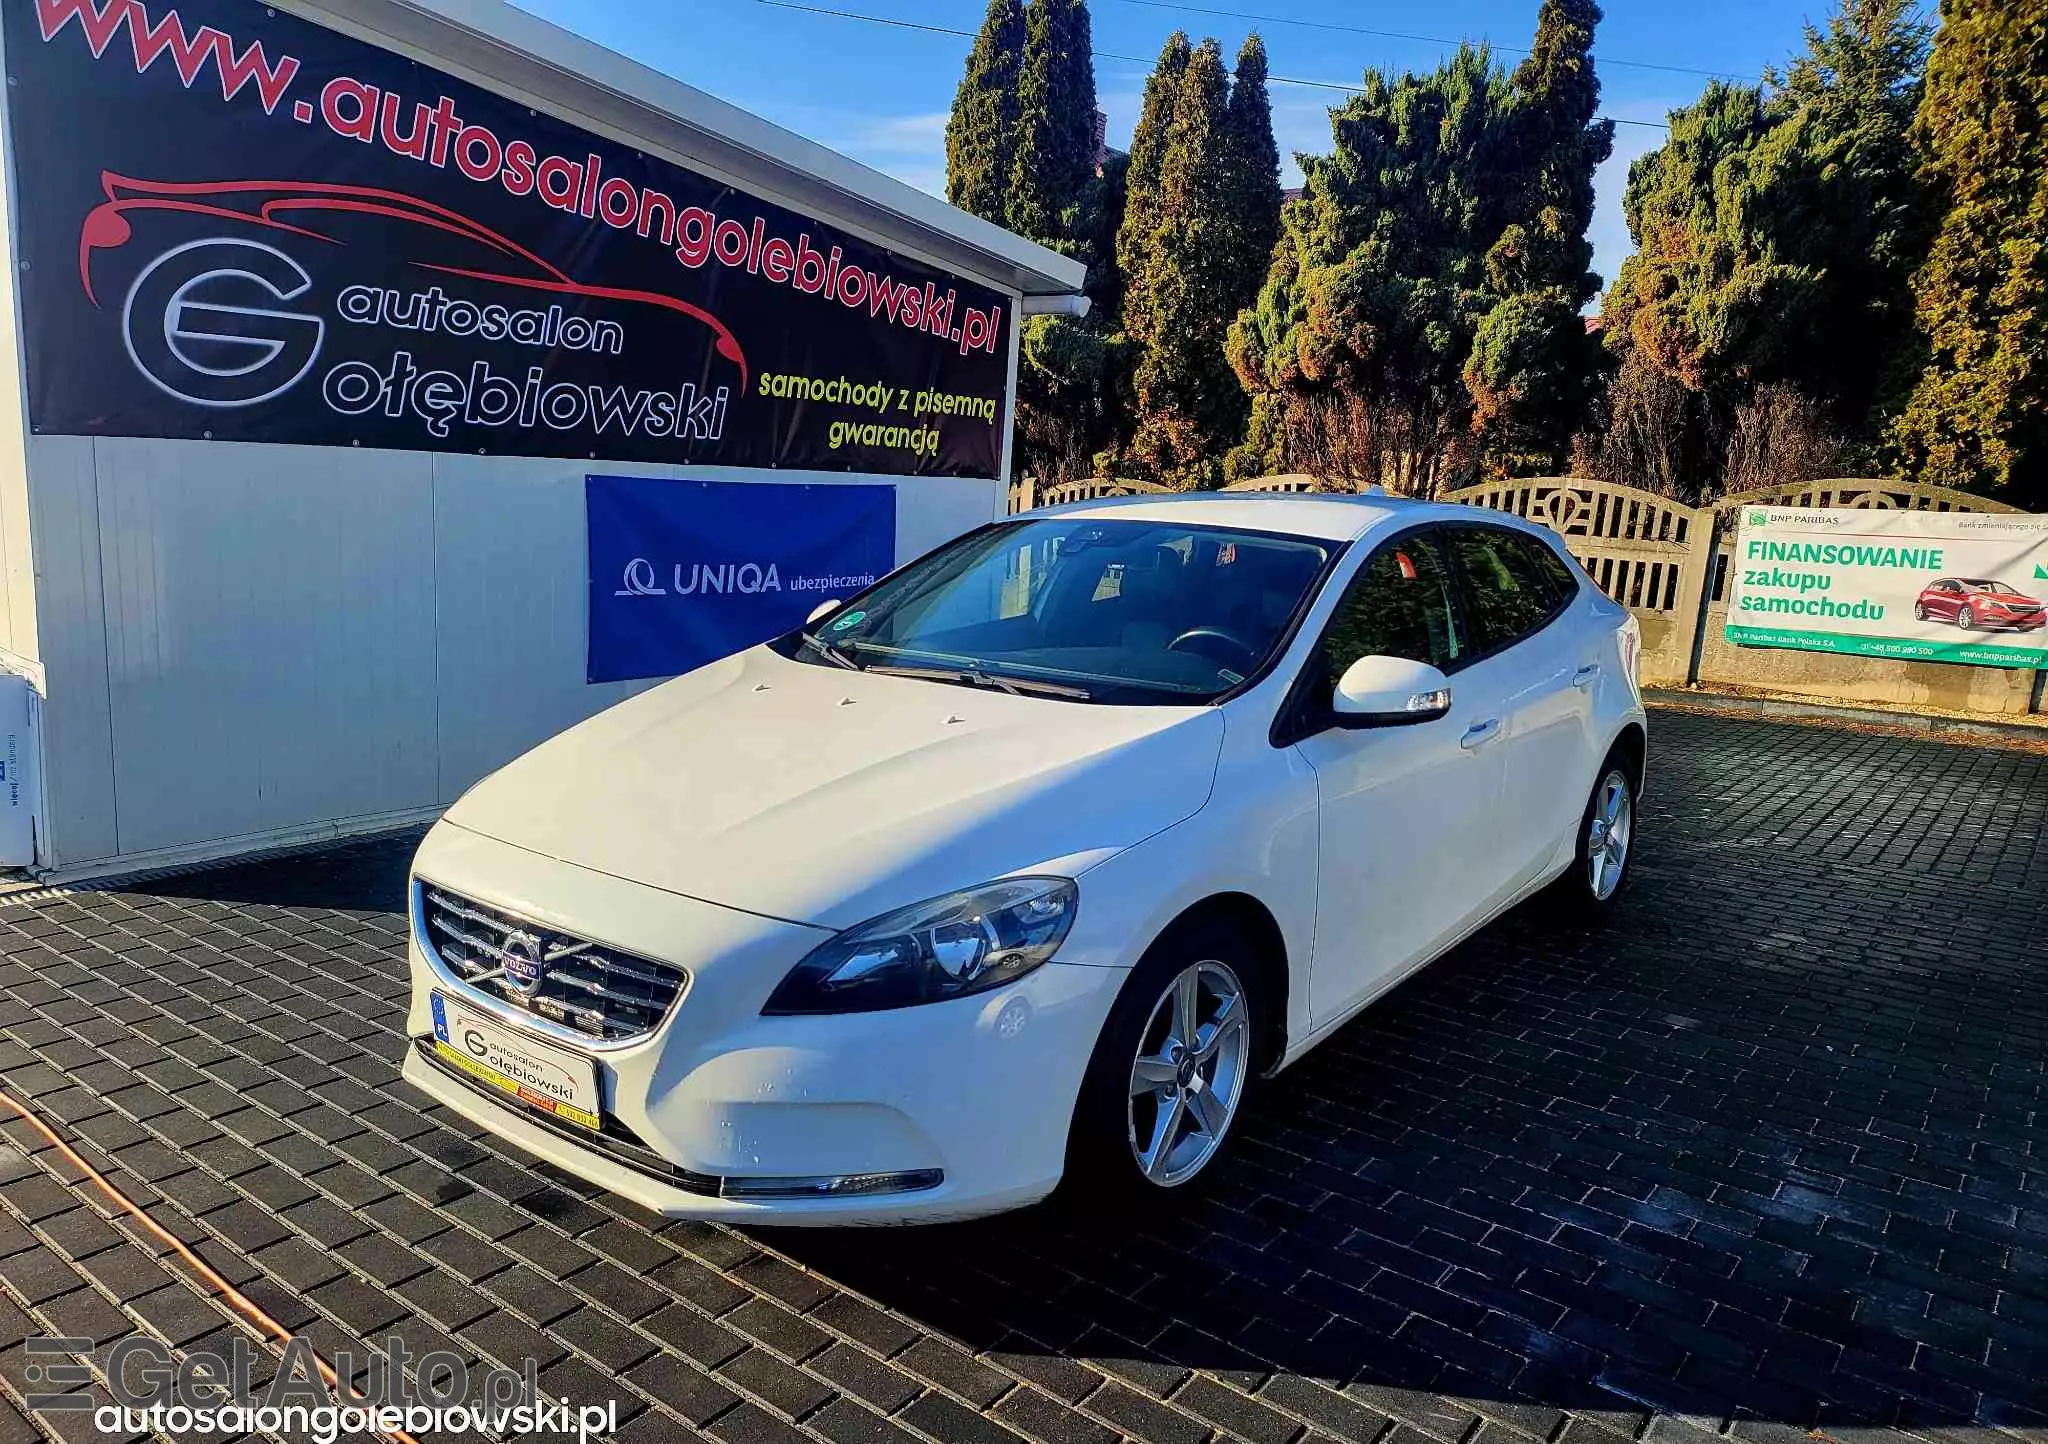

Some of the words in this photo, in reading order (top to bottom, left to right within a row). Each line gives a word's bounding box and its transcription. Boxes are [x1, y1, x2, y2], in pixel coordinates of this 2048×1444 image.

[34, 0, 1002, 356] www.autosalongolebiowski.pl
[336, 284, 624, 354] autosalon
[758, 372, 894, 413] samochody
[897, 388, 908, 411] z
[914, 386, 997, 424] pisemną
[828, 419, 941, 456] gwarancją
[1770, 513, 1793, 523] BNP
[1795, 514, 1840, 526] PARIBAS
[1747, 540, 1944, 570] FINANSOWANIE
[674, 562, 782, 595] UNIQA
[790, 571, 875, 593] ubezpieczenia
[1743, 568, 1832, 595] zakupu
[1740, 595, 1885, 622] samochodu
[504, 956, 537, 976] VOLVO
[437, 1023, 448, 1038] PL
[489, 1043, 543, 1073] autosalon
